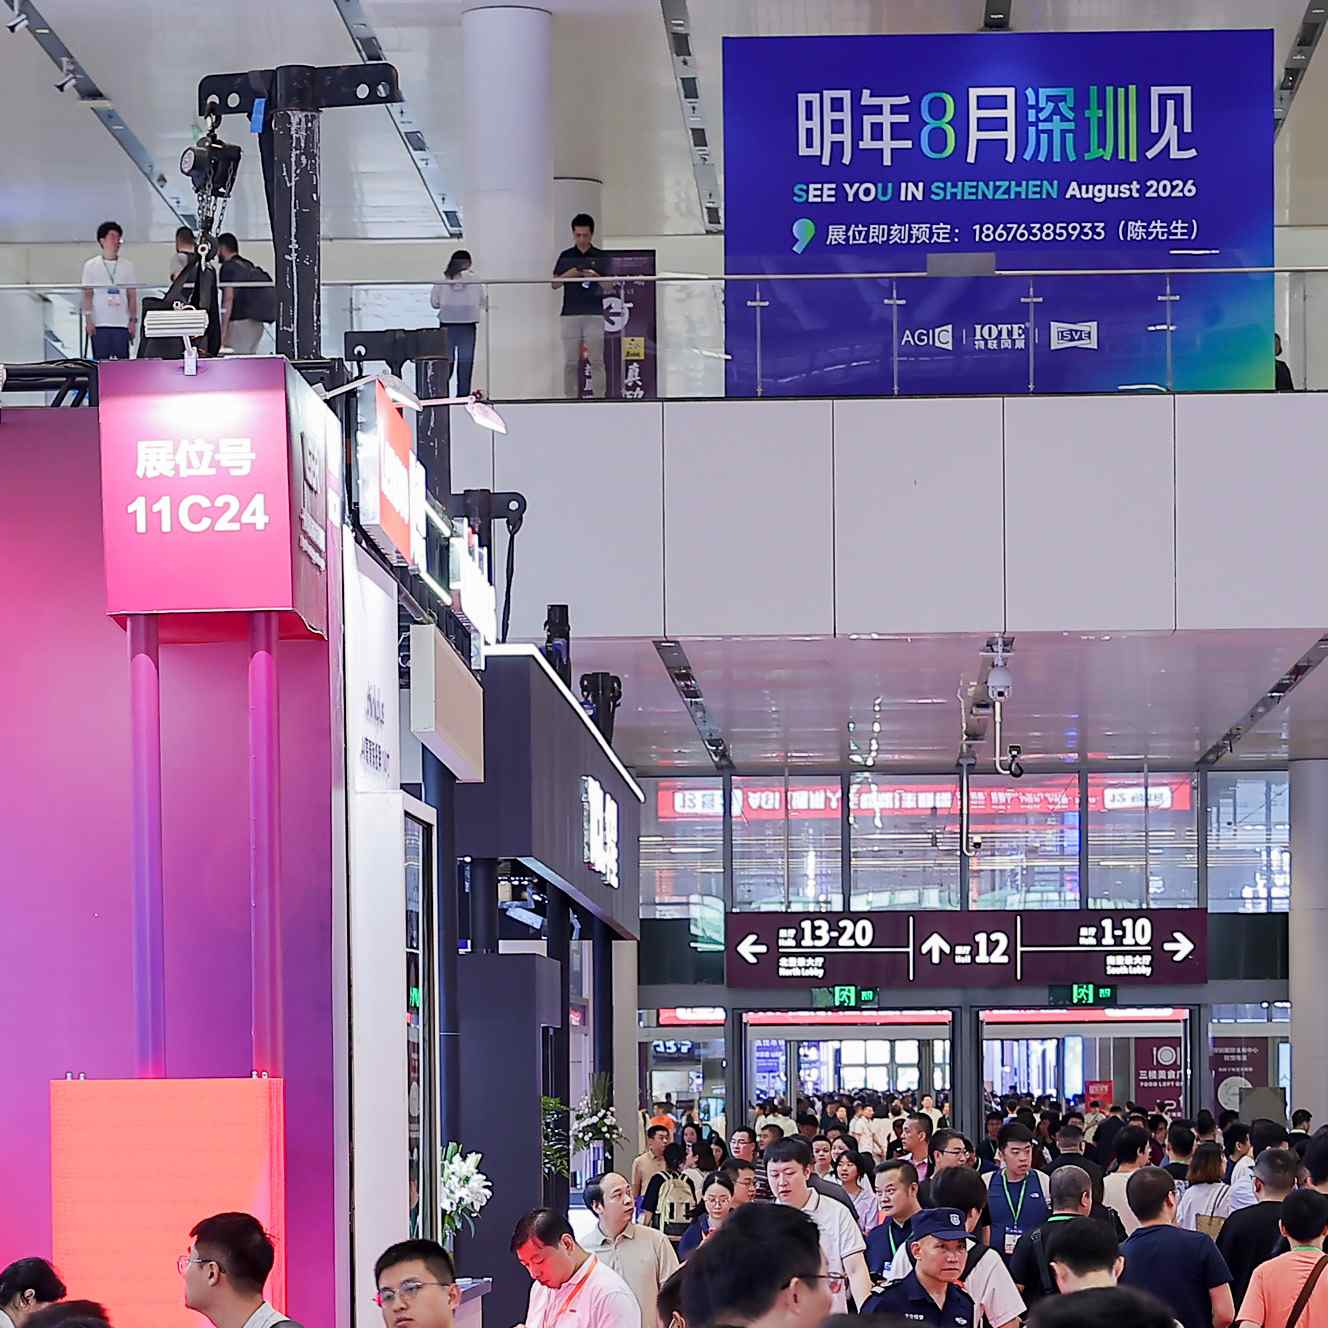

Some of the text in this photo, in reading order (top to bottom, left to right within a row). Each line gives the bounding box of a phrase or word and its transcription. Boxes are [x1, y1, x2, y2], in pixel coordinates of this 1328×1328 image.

[796, 85, 1198, 166] 明年8月深圳见
[792, 179, 1197, 203] SEE YOU IN SHENZHEN August 2026
[974, 324, 1025, 340] IOTE
[136, 439, 256, 478] 展位号
[126, 493, 270, 533] 11C24
[800, 919, 874, 947] 13-20
[1101, 917, 1152, 945] 1-10
[974, 932, 1009, 964] 12
